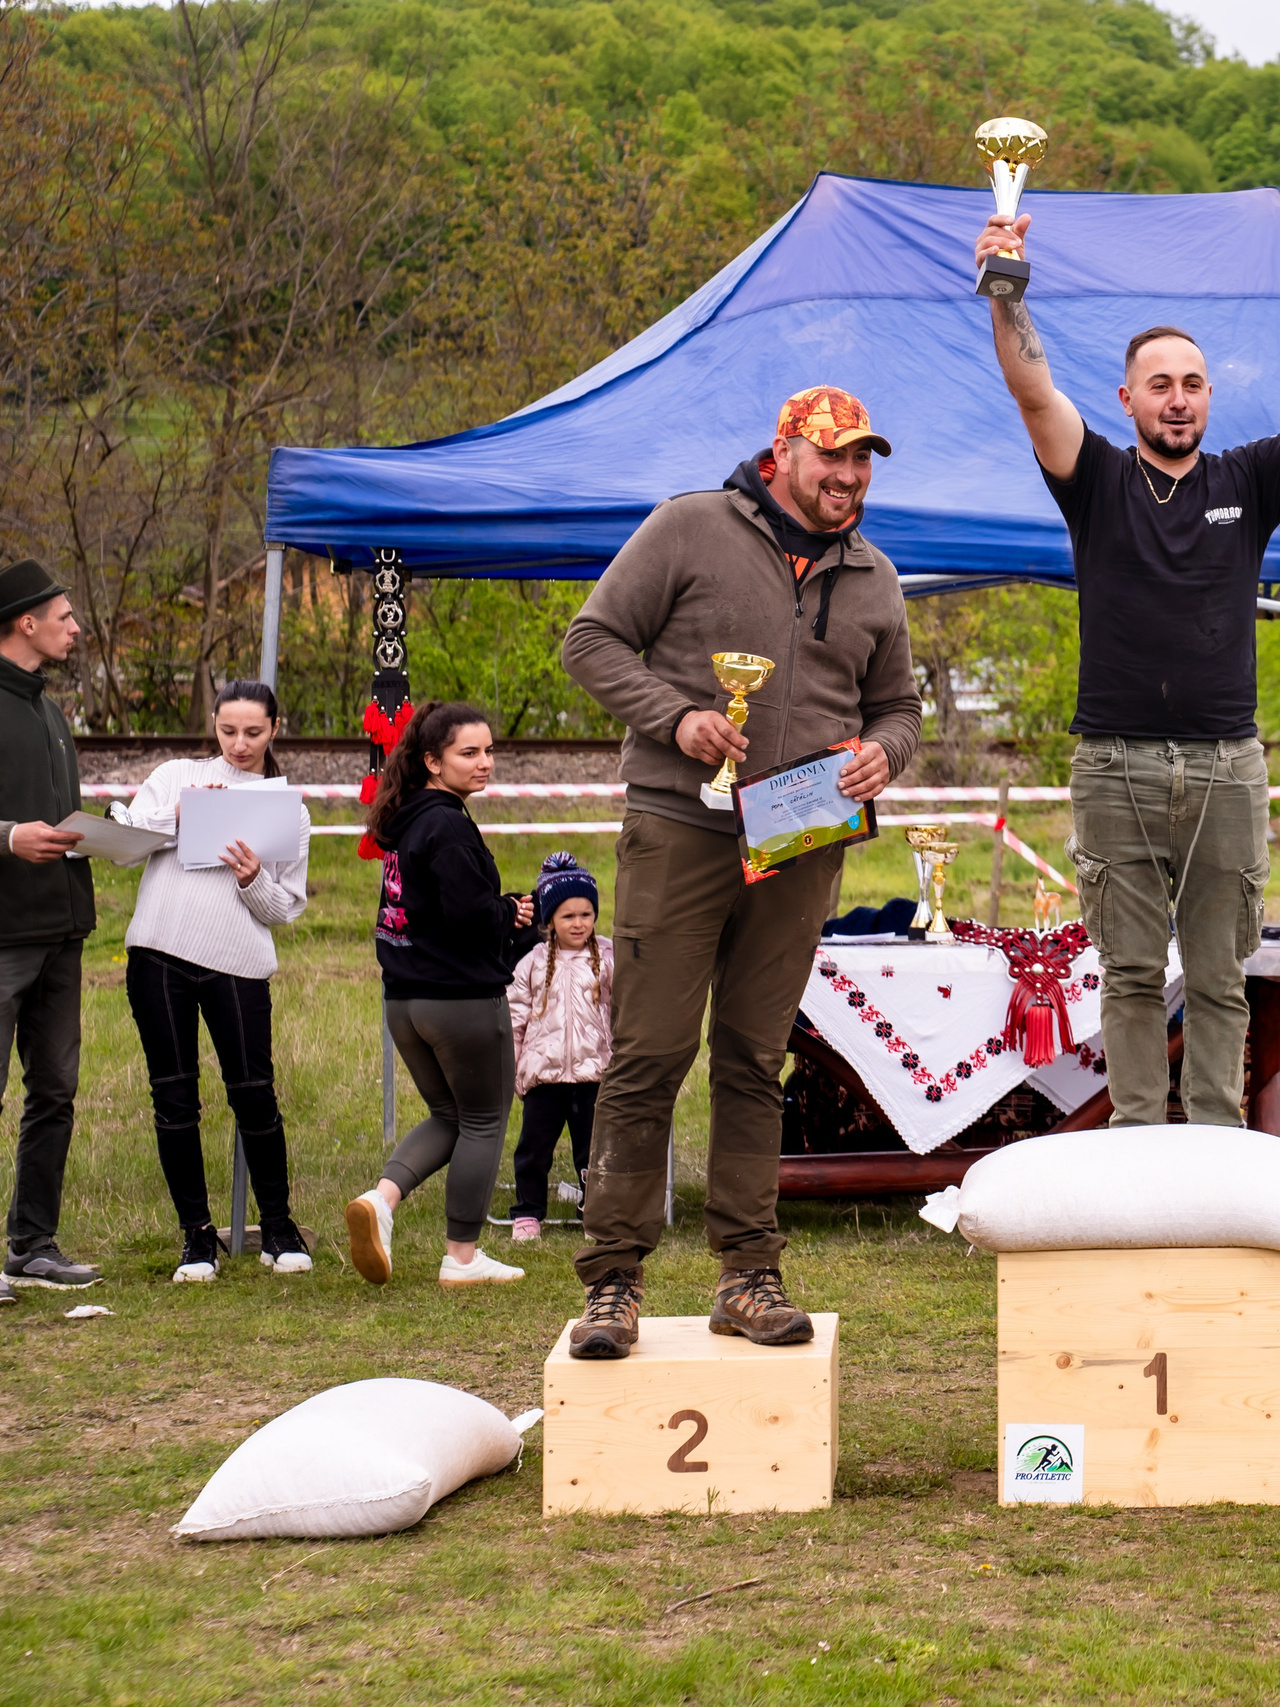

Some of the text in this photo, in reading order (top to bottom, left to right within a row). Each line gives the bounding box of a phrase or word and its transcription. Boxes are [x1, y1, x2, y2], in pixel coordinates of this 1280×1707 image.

[770, 761, 826, 791] DIPLOMĂ
[1143, 1352, 1168, 1415] 1
[667, 1409, 709, 1473] 2
[1015, 1472, 1071, 1481] PRO ATLETIC
